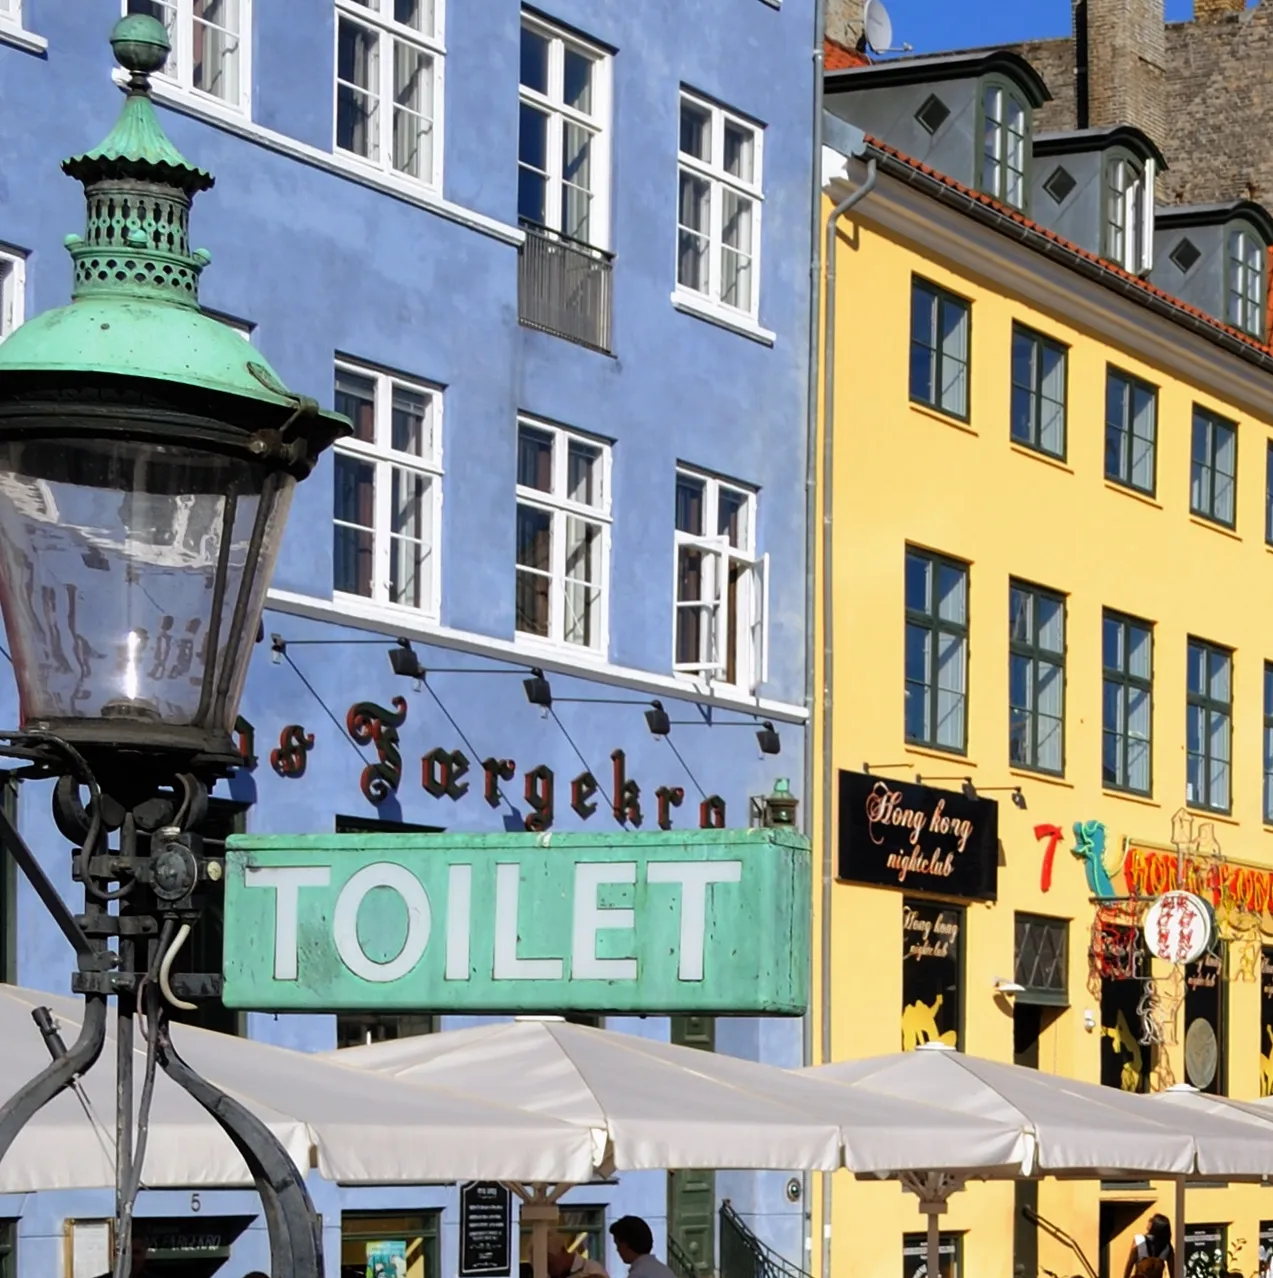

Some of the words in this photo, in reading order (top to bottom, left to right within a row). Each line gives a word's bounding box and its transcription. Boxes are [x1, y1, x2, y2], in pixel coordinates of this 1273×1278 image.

[866, 781, 926, 845] Hong
[929, 798, 973, 853] kong
[886, 844, 954, 882] nightclub
[1033, 823, 1064, 893] 7
[244, 861, 743, 983] TOILET
[191, 1193, 201, 1212] 5
